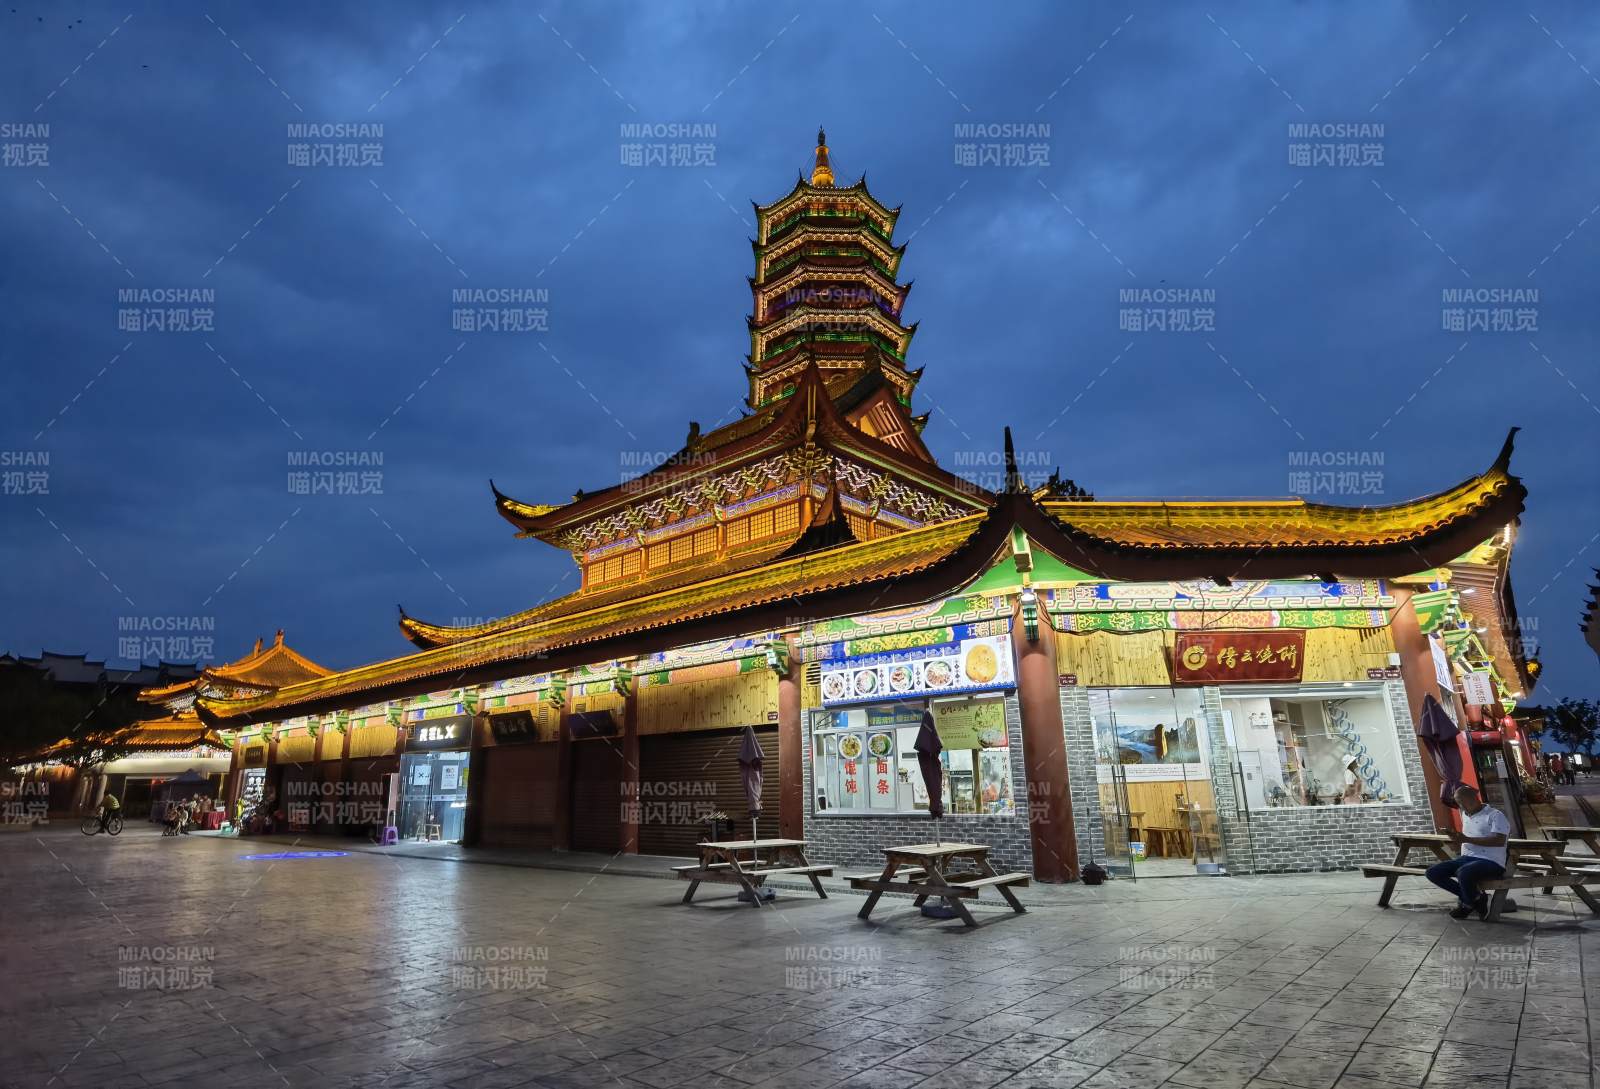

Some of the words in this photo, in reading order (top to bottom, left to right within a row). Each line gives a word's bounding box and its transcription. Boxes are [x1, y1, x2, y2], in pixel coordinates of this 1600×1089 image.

[419, 723, 456, 742] RELX
[844, 758, 858, 794] 馄饨
[875, 757, 890, 795] 面条
